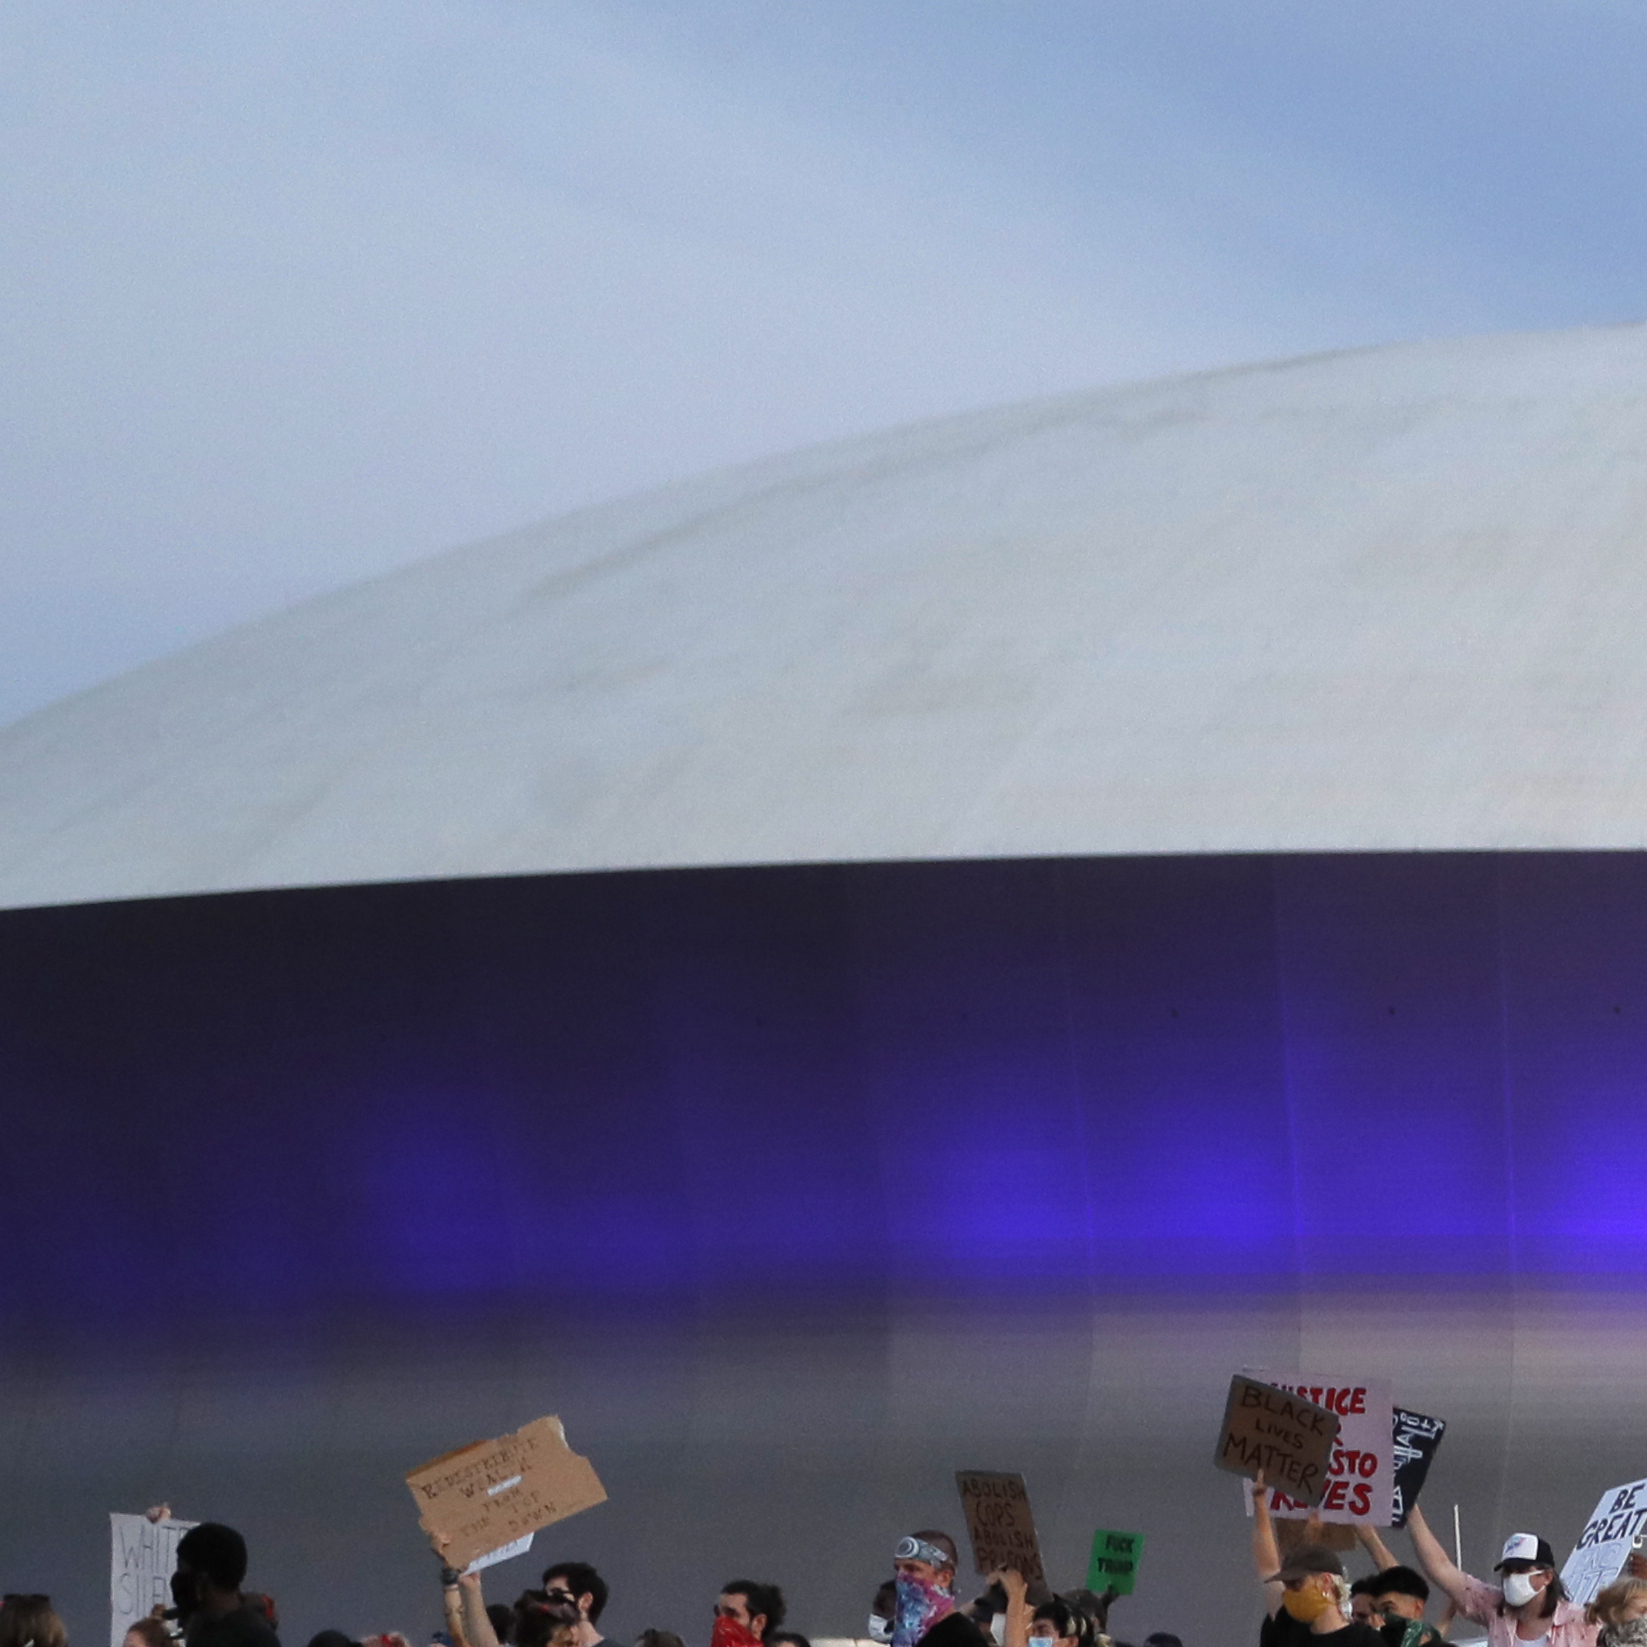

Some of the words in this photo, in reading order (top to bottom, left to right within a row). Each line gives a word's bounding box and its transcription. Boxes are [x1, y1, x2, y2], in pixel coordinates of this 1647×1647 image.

[1239, 1385, 1325, 1436] BLACK
[1255, 1419, 1304, 1450] LIVES
[1222, 1432, 1319, 1495] MATTER
[962, 1478, 1027, 1502] ABOLISH
[1609, 1483, 1645, 1514] BE
[976, 1500, 1015, 1527] COPS
